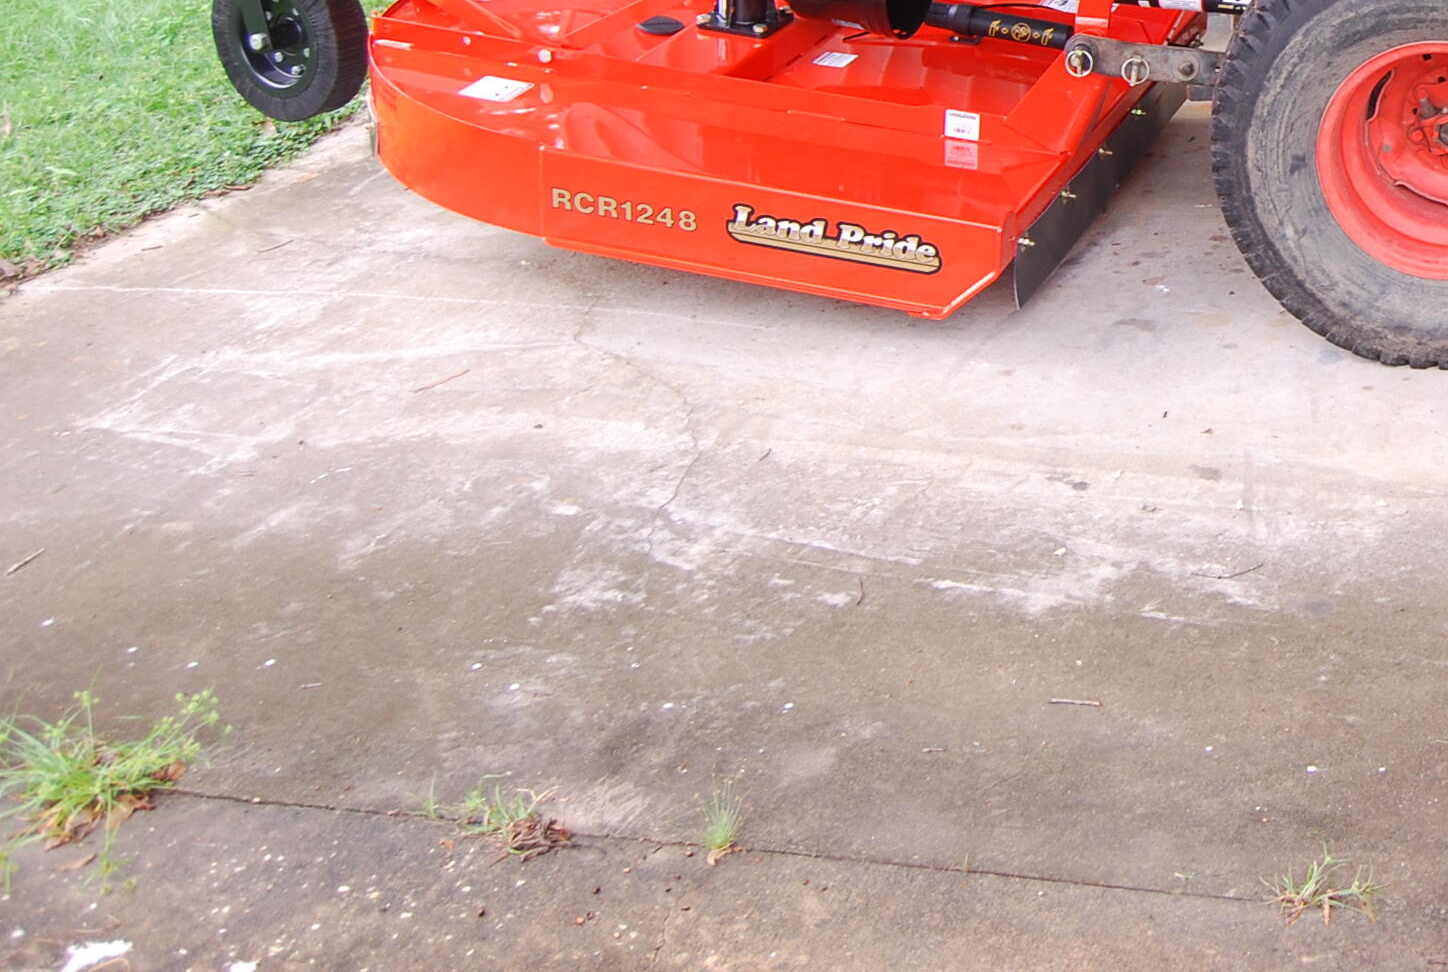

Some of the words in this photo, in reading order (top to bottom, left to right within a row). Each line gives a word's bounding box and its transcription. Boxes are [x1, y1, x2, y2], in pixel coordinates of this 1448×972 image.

[551, 187, 697, 232] RCR1248
[731, 203, 827, 246] Land
[836, 222, 938, 264] Pride
